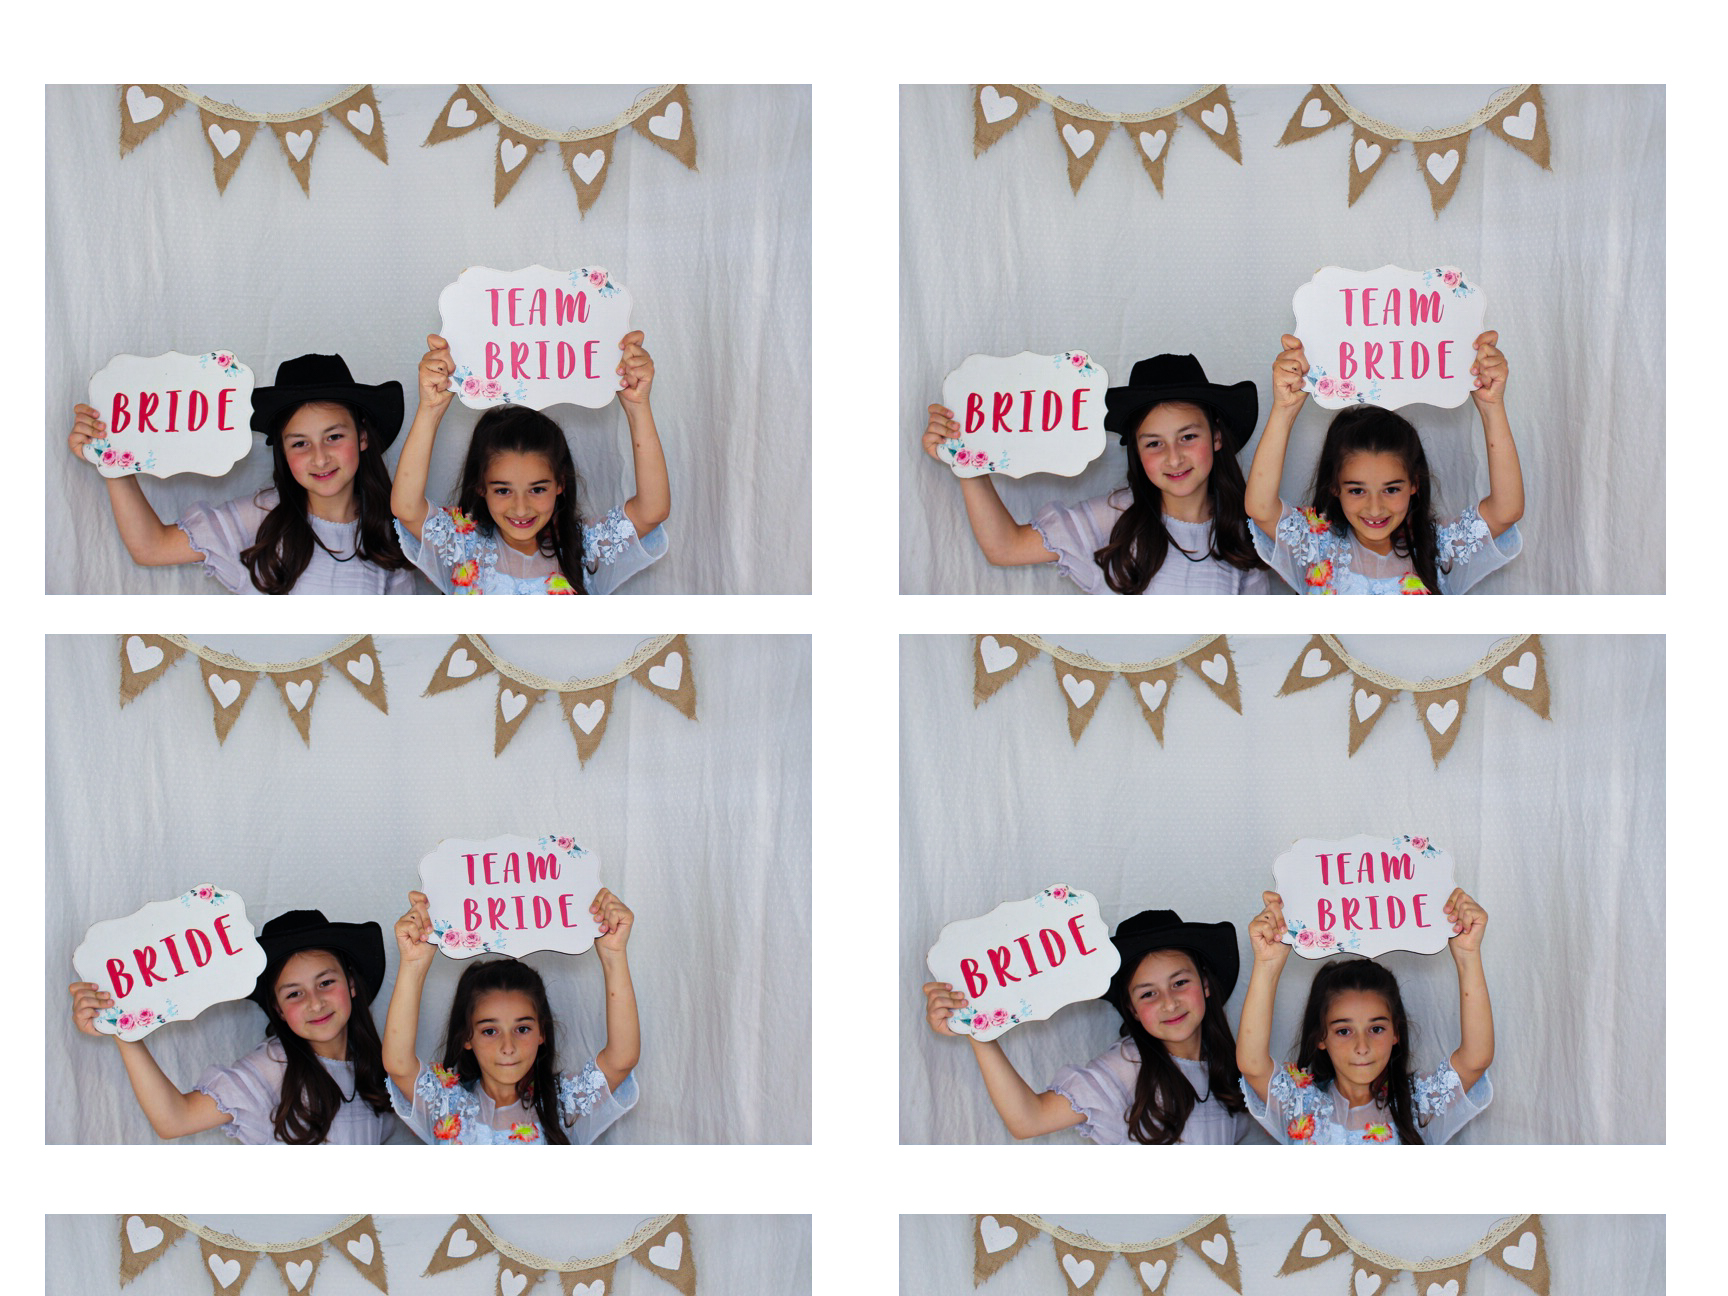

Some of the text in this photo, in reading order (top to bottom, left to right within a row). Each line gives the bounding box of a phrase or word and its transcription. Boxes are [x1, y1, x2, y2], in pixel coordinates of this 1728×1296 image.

[484, 287, 590, 327] TEAM
[1338, 287, 1444, 327] TEAM
[485, 340, 601, 380] BRIDE
[1339, 340, 1455, 380] BRIDE
[111, 387, 236, 435] BRIDE
[965, 387, 1090, 435] BRIDE
[461, 851, 562, 886] TEAM
[1315, 851, 1416, 886] TEAM
[463, 893, 578, 934] BRIDE
[1317, 893, 1432, 934] BRIDE
[105, 913, 243, 1000] BRIDE
[959, 913, 1097, 1000] BRIDE
